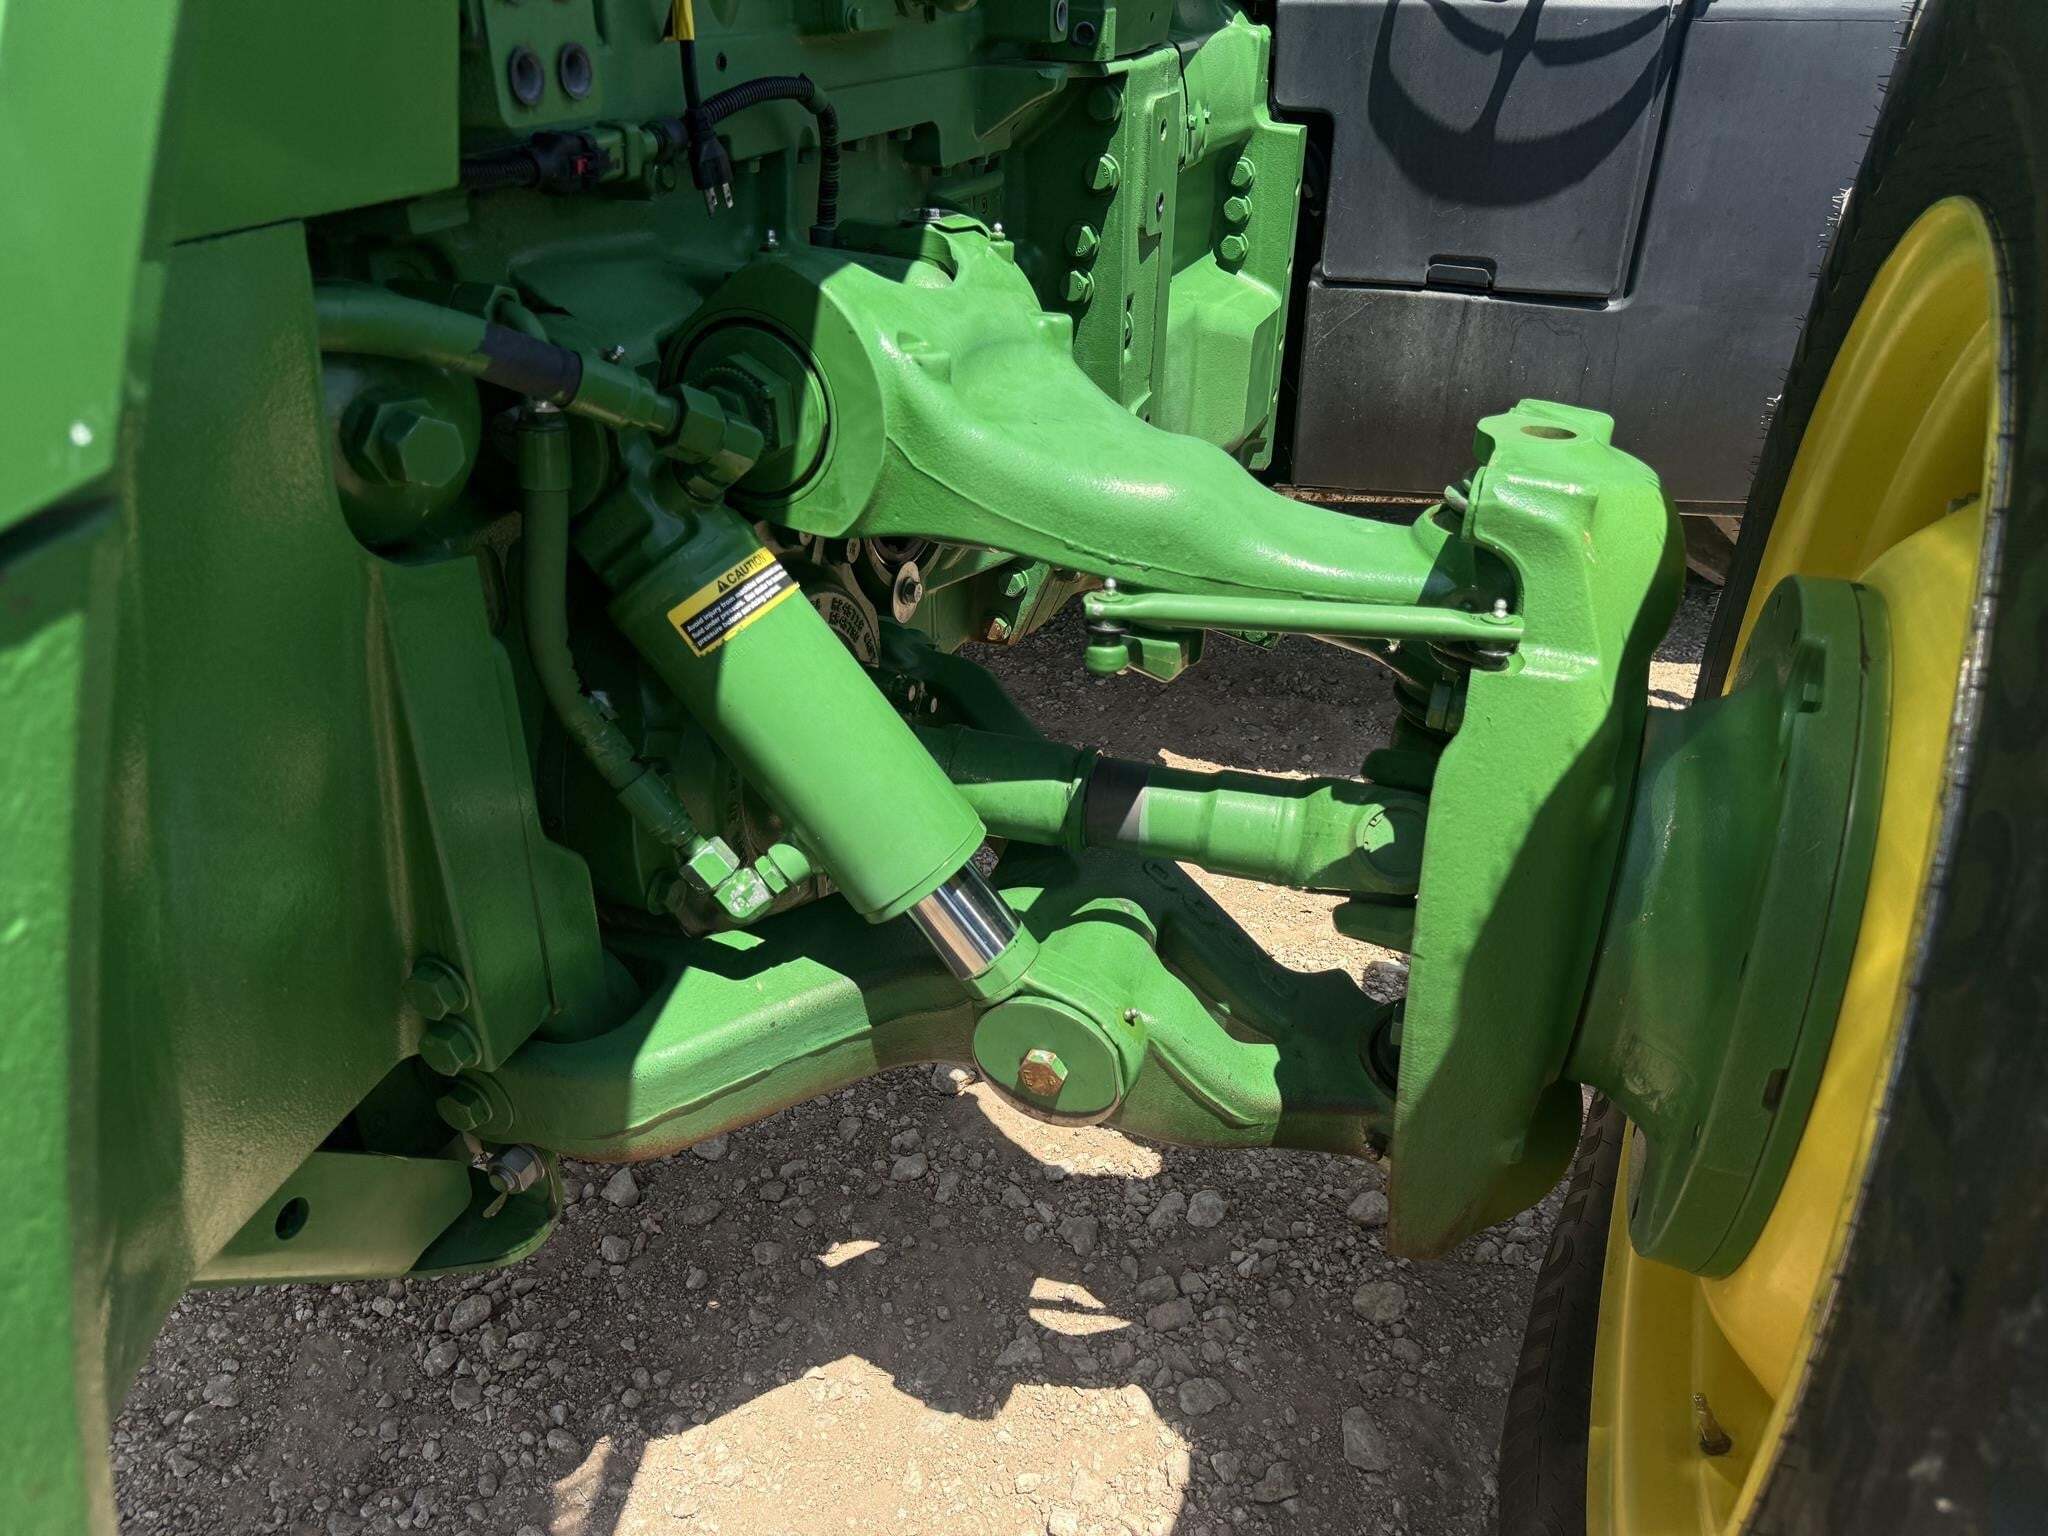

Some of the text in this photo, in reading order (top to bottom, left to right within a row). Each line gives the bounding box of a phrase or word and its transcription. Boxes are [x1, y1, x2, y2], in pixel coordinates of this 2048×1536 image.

[725, 552, 766, 584] CAUTION
[686, 595, 735, 631] Avoid injury from
[703, 615, 721, 630] under
[696, 625, 723, 646] pressure
